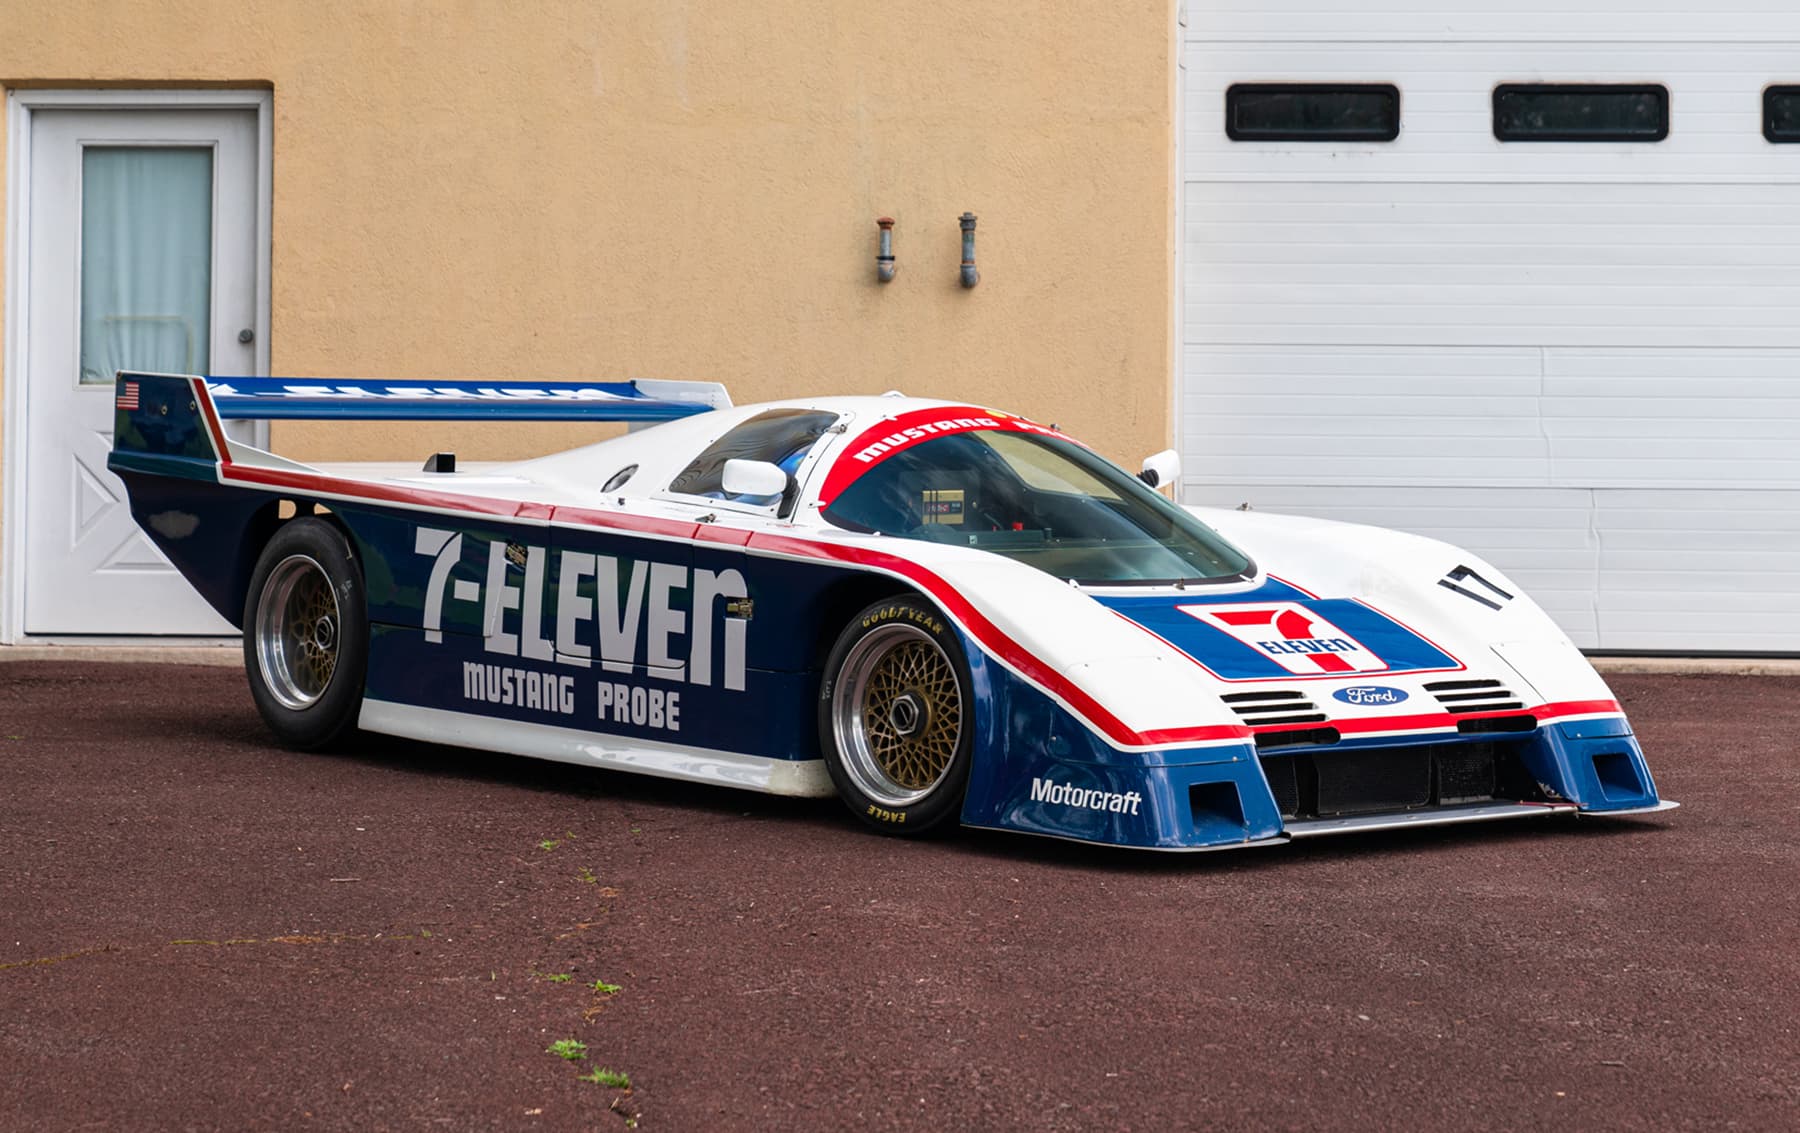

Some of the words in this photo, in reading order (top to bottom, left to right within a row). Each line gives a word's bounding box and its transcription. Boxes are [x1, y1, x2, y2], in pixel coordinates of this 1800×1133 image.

[853, 418, 1001, 463] MUSTANG
[1437, 564, 1514, 611] 17
[463, 661, 574, 714] MUSTANG
[598, 681, 680, 731] PROBE
[1346, 688, 1397, 703] Ford
[867, 804, 906, 823] EAGLE
[1030, 777, 1142, 816] Motorcraft
